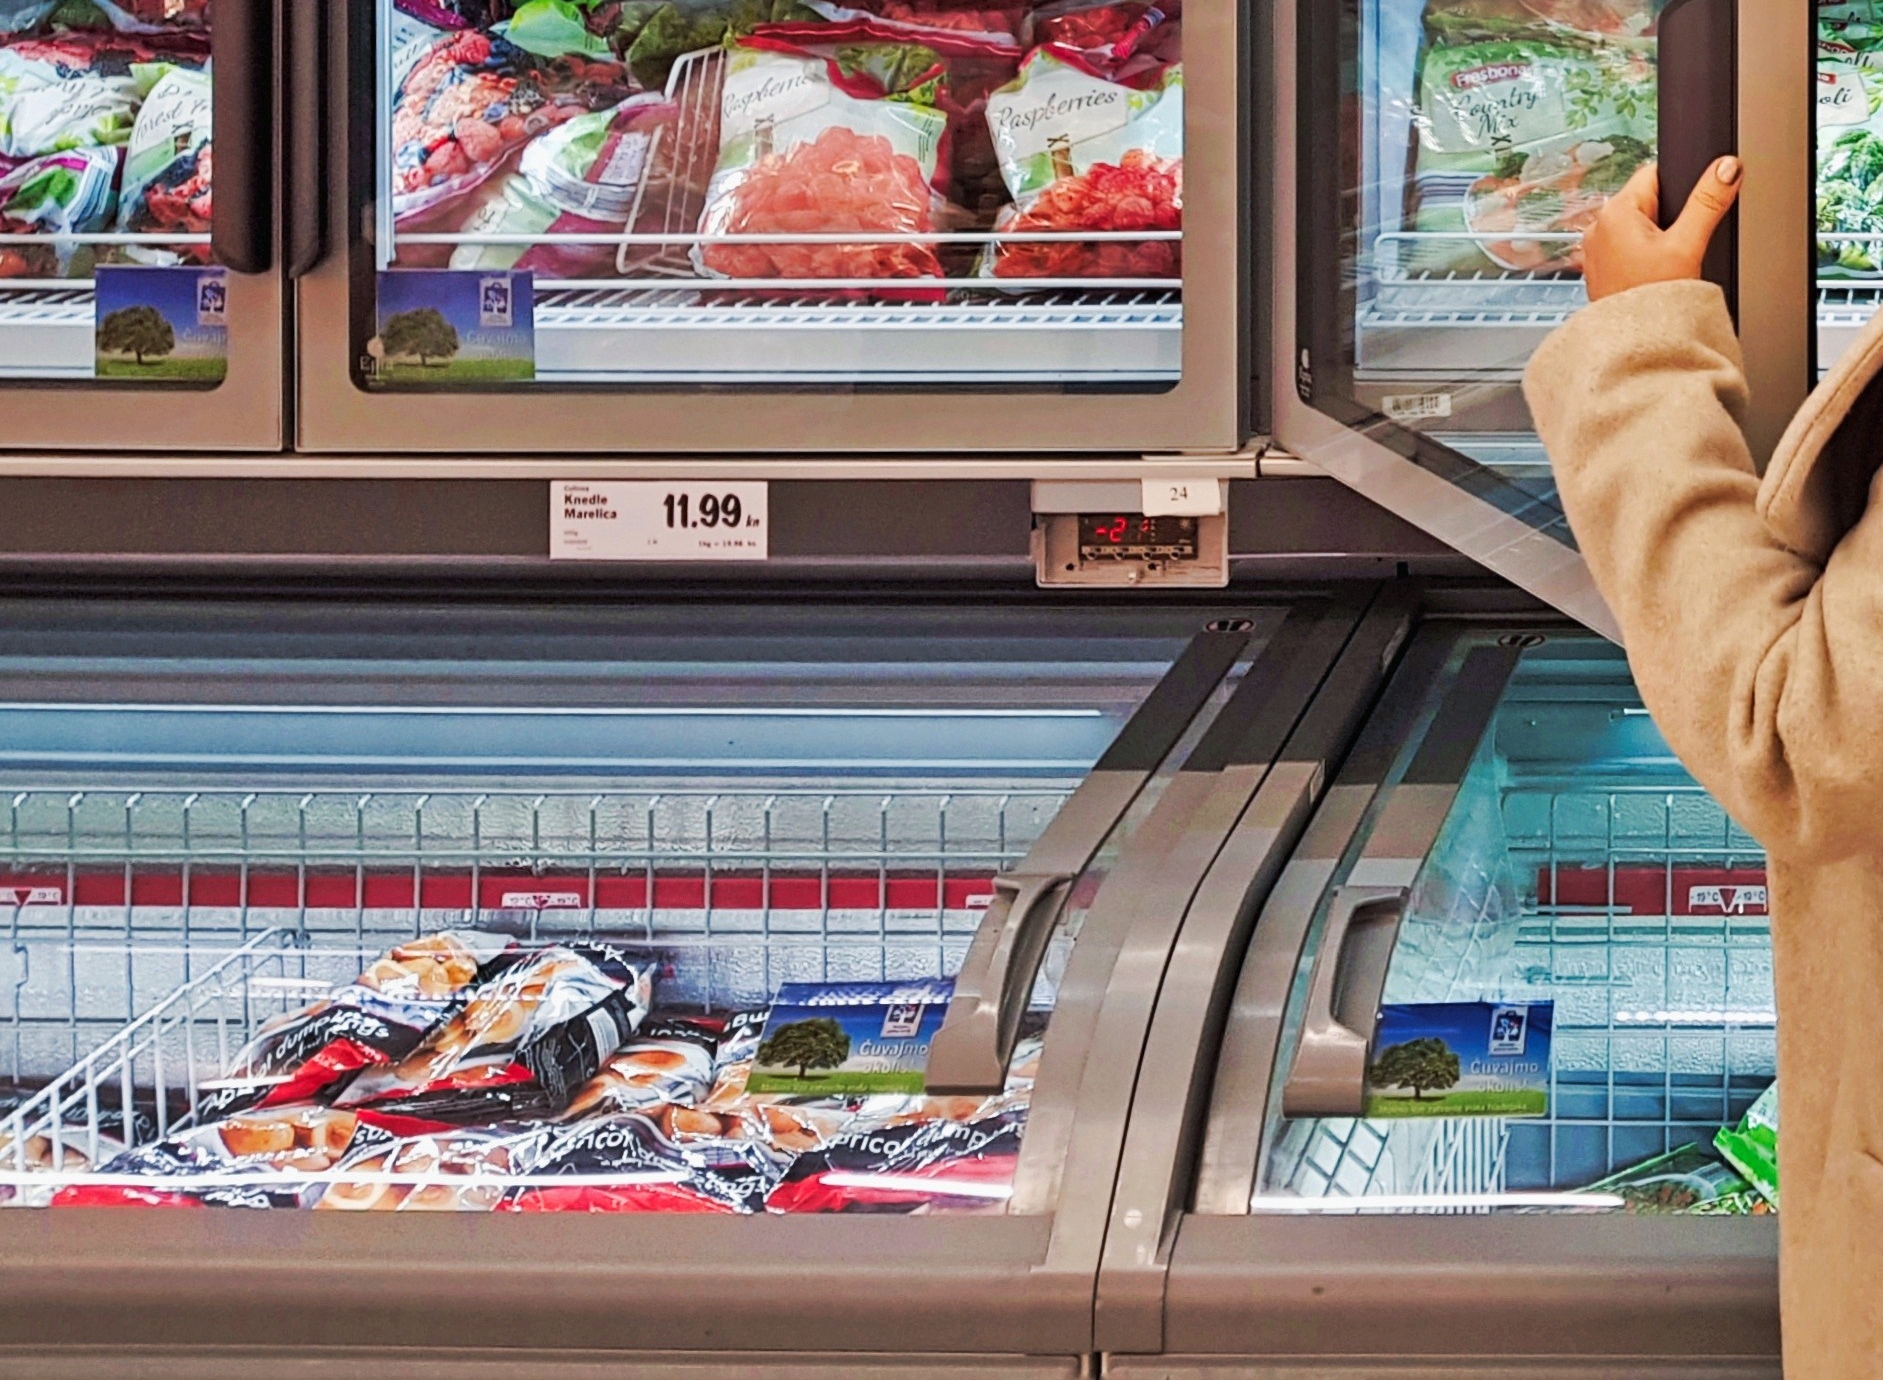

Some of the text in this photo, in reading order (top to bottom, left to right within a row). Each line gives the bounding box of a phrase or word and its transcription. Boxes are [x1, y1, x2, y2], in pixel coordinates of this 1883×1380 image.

[999, 87, 1119, 132] Raspberries
[1458, 86, 1537, 116] Country
[564, 494, 608, 506] Knedle
[1170, 486, 1188, 501] 24
[564, 508, 618, 520] Marelica
[663, 493, 760, 528] 11.99 kn
[859, 1039, 929, 1058] Čuvajmo
[1470, 1060, 1539, 1076] Čuvajmo
